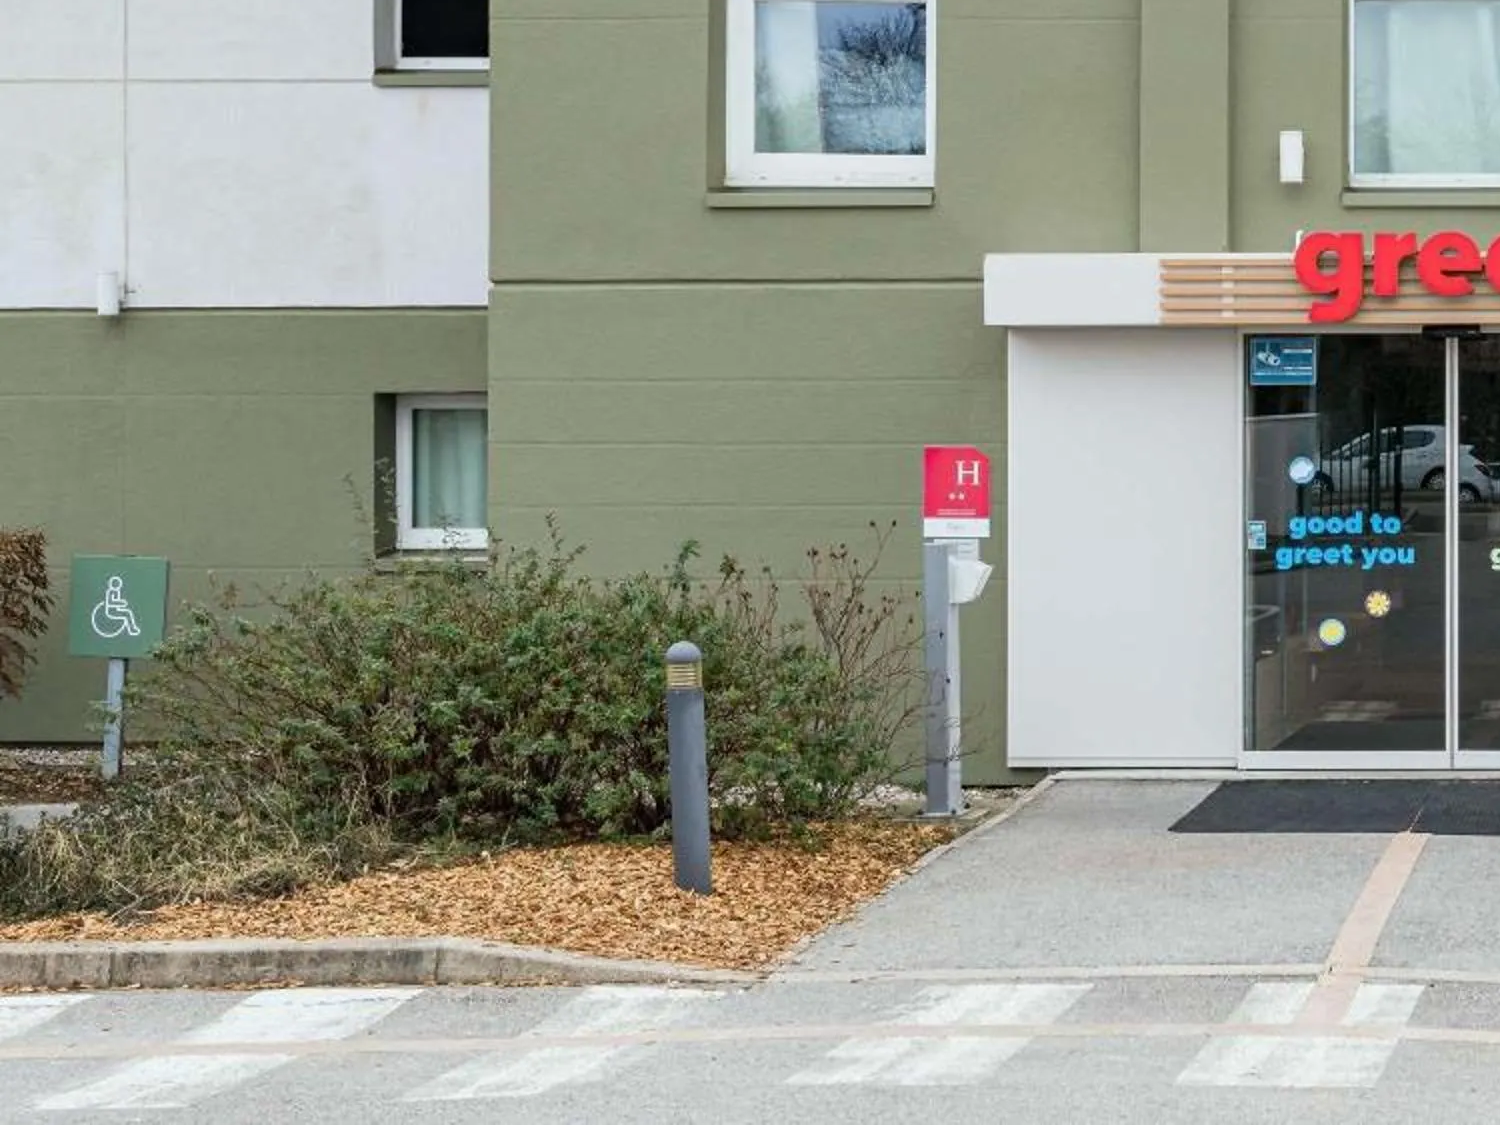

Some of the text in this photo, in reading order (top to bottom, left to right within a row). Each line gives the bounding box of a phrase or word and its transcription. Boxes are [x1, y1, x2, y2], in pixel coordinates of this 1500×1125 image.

[955, 459, 980, 485] H
[1289, 510, 1402, 539] good to
[1275, 544, 1415, 570] greet you
